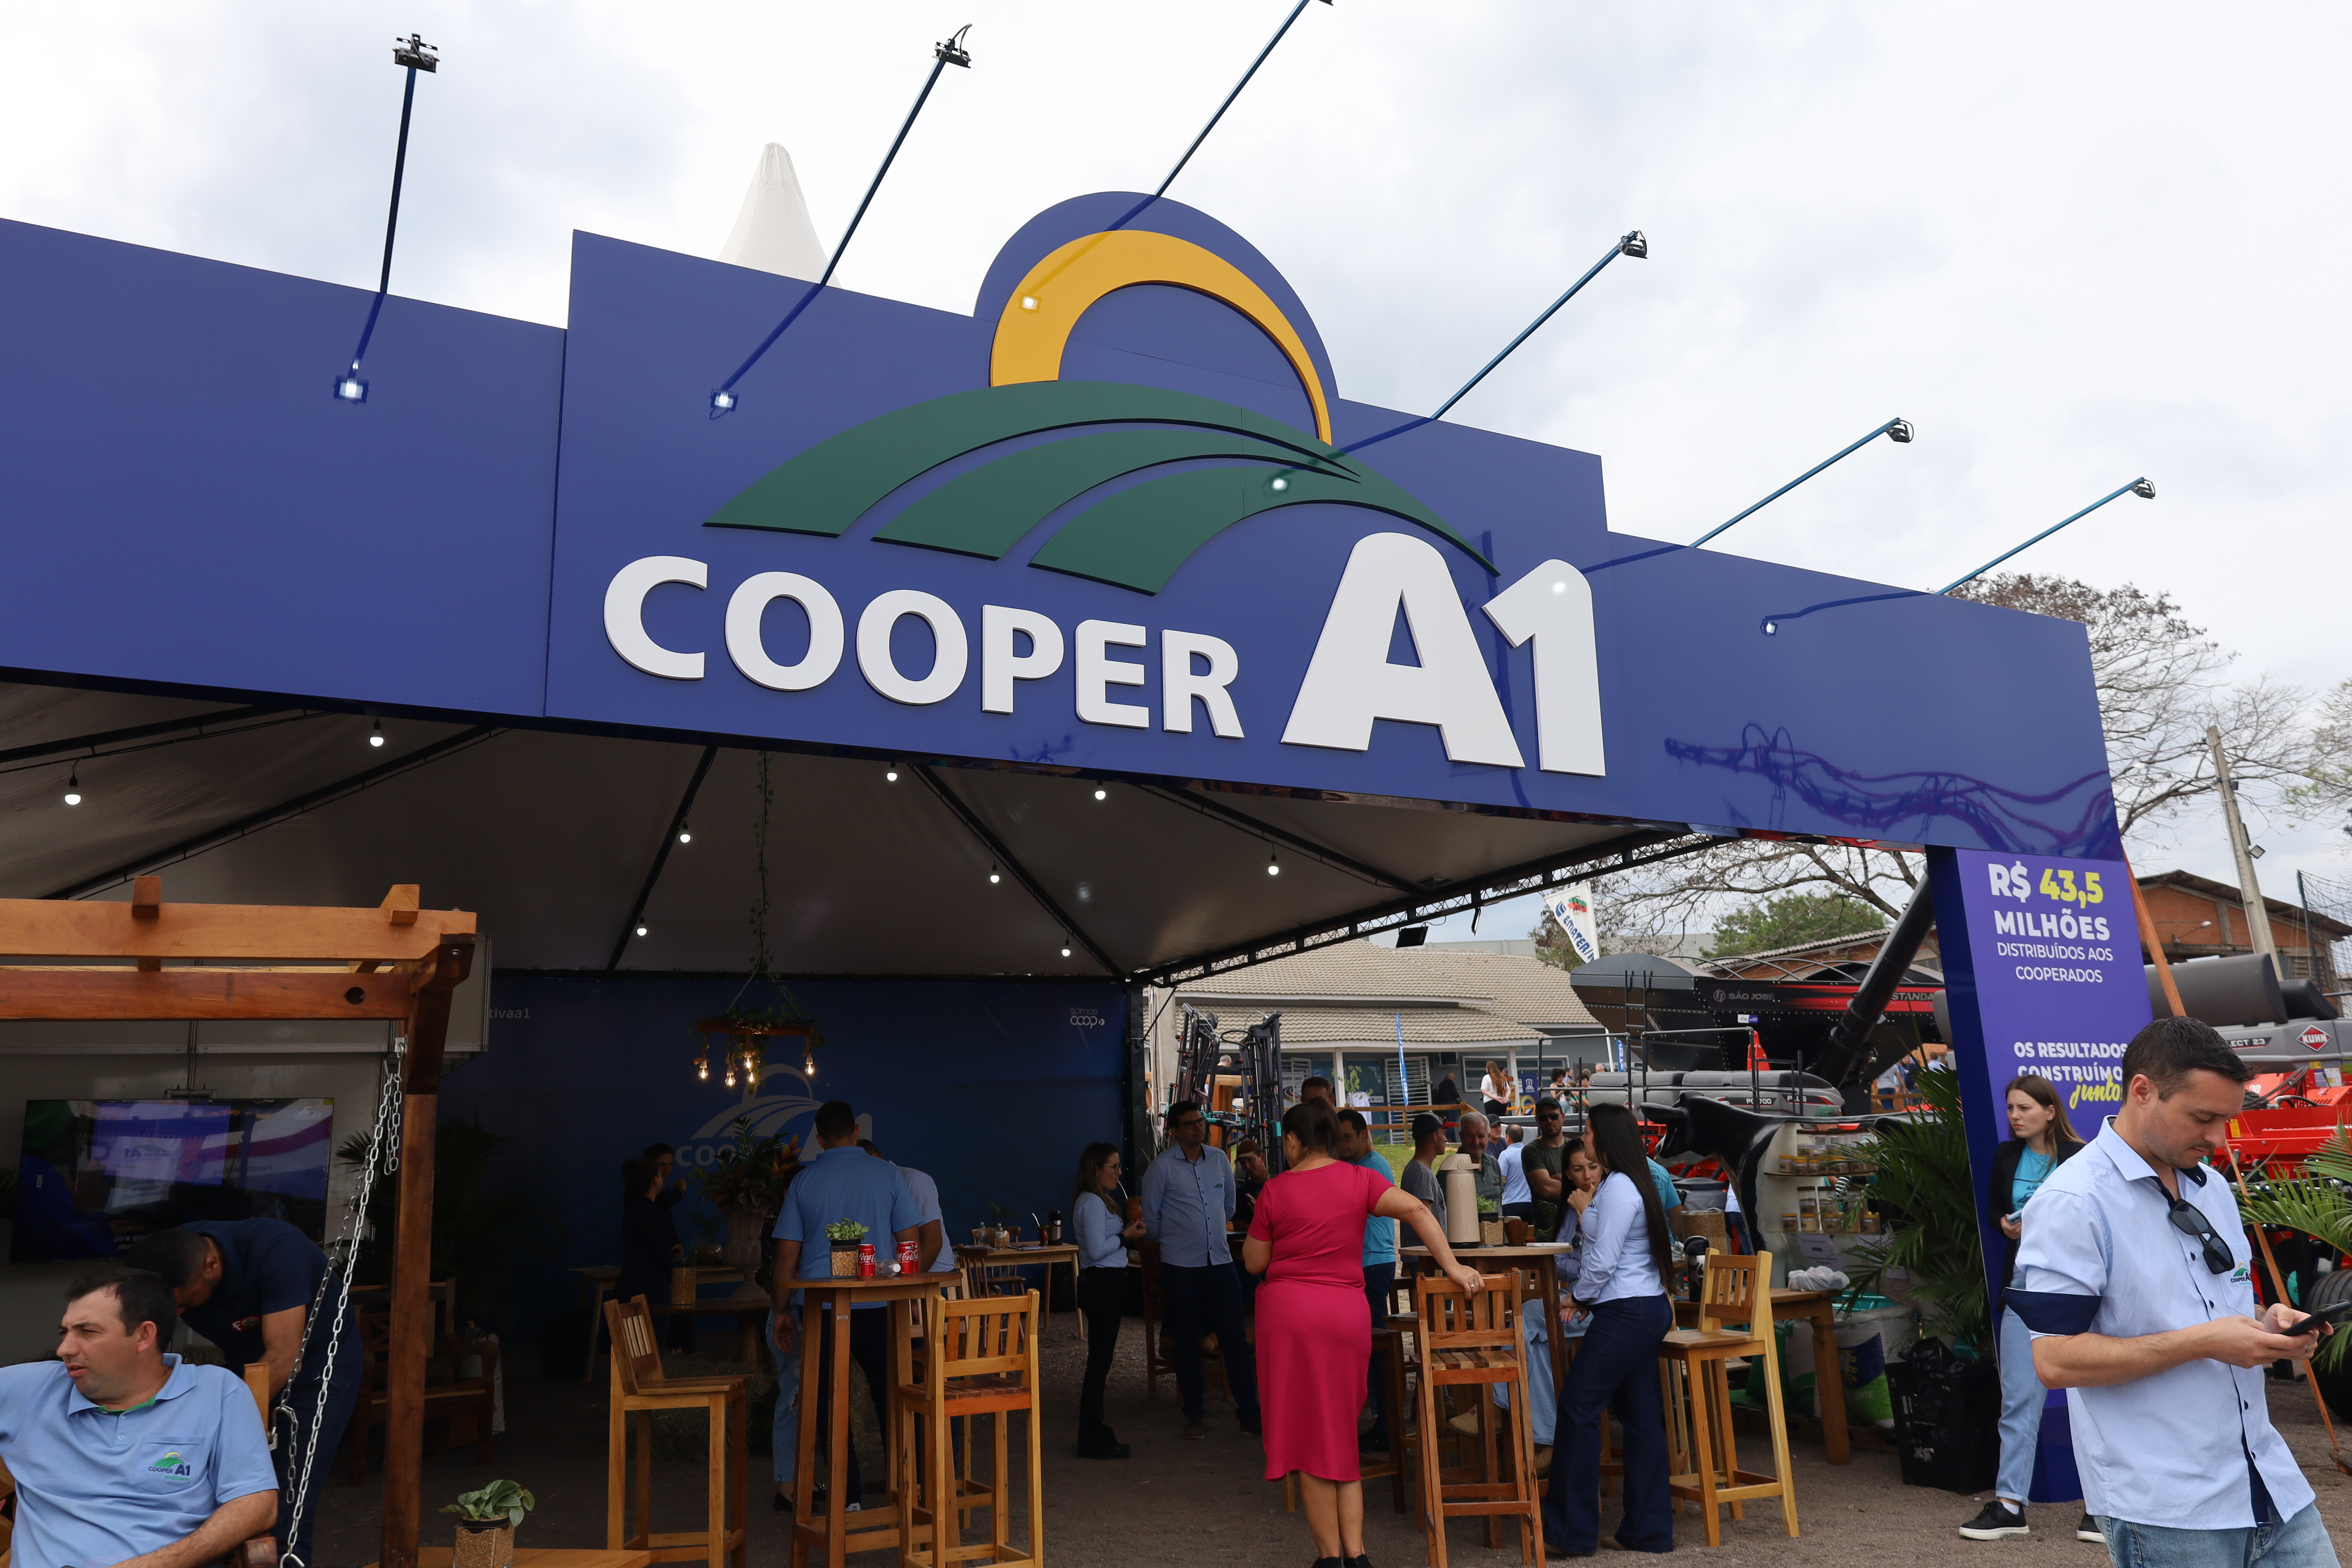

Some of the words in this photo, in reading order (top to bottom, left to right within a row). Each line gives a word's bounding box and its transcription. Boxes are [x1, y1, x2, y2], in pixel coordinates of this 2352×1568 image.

[602, 555, 1245, 739] COOPER
[1281, 531, 1607, 777] A1
[1988, 861, 2031, 903] R$
[2039, 868, 2104, 909] 43,5
[1994, 908, 2110, 941] MILHÕES
[1997, 942, 2085, 960] DISTRIBUÍDOS
[2088, 947, 2113, 962] AOS
[2015, 965, 2104, 983] COOPERADOS
[1728, 991, 1749, 1000] SÃO
[1750, 992, 1775, 1000] JOSÉ
[1070, 1015, 1098, 1029] coop
[2301, 1033, 2328, 1044] KUHN
[2014, 1041, 2035, 1058] OS
[2037, 1041, 2128, 1058] RESULTADOS
[2069, 1073, 2123, 1110] junto
[174, 1464, 191, 1476] A1
